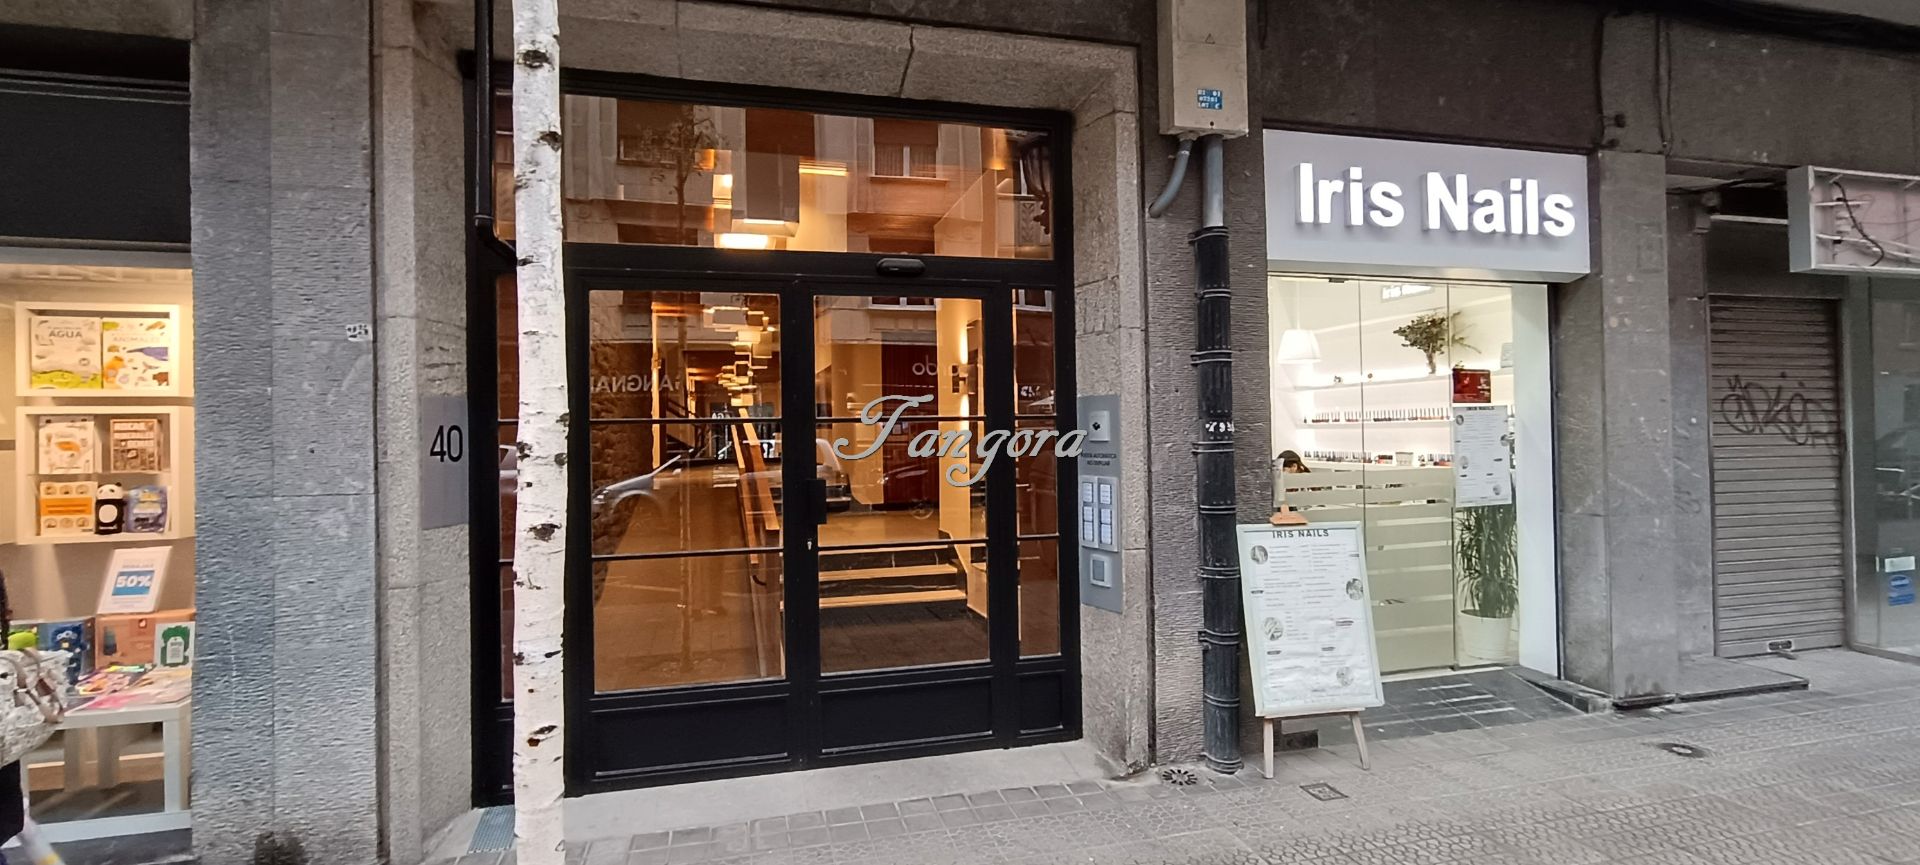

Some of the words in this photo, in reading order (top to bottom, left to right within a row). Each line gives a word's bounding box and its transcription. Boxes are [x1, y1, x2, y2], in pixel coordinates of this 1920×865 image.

[1297, 162, 1405, 227] Iris
[1425, 171, 1576, 237] Nails
[49, 329, 83, 338] AGUA
[429, 424, 464, 463] 40
[1272, 530, 1294, 539] IRIS
[1297, 529, 1329, 538] NAILS
[115, 575, 152, 588] 50%
